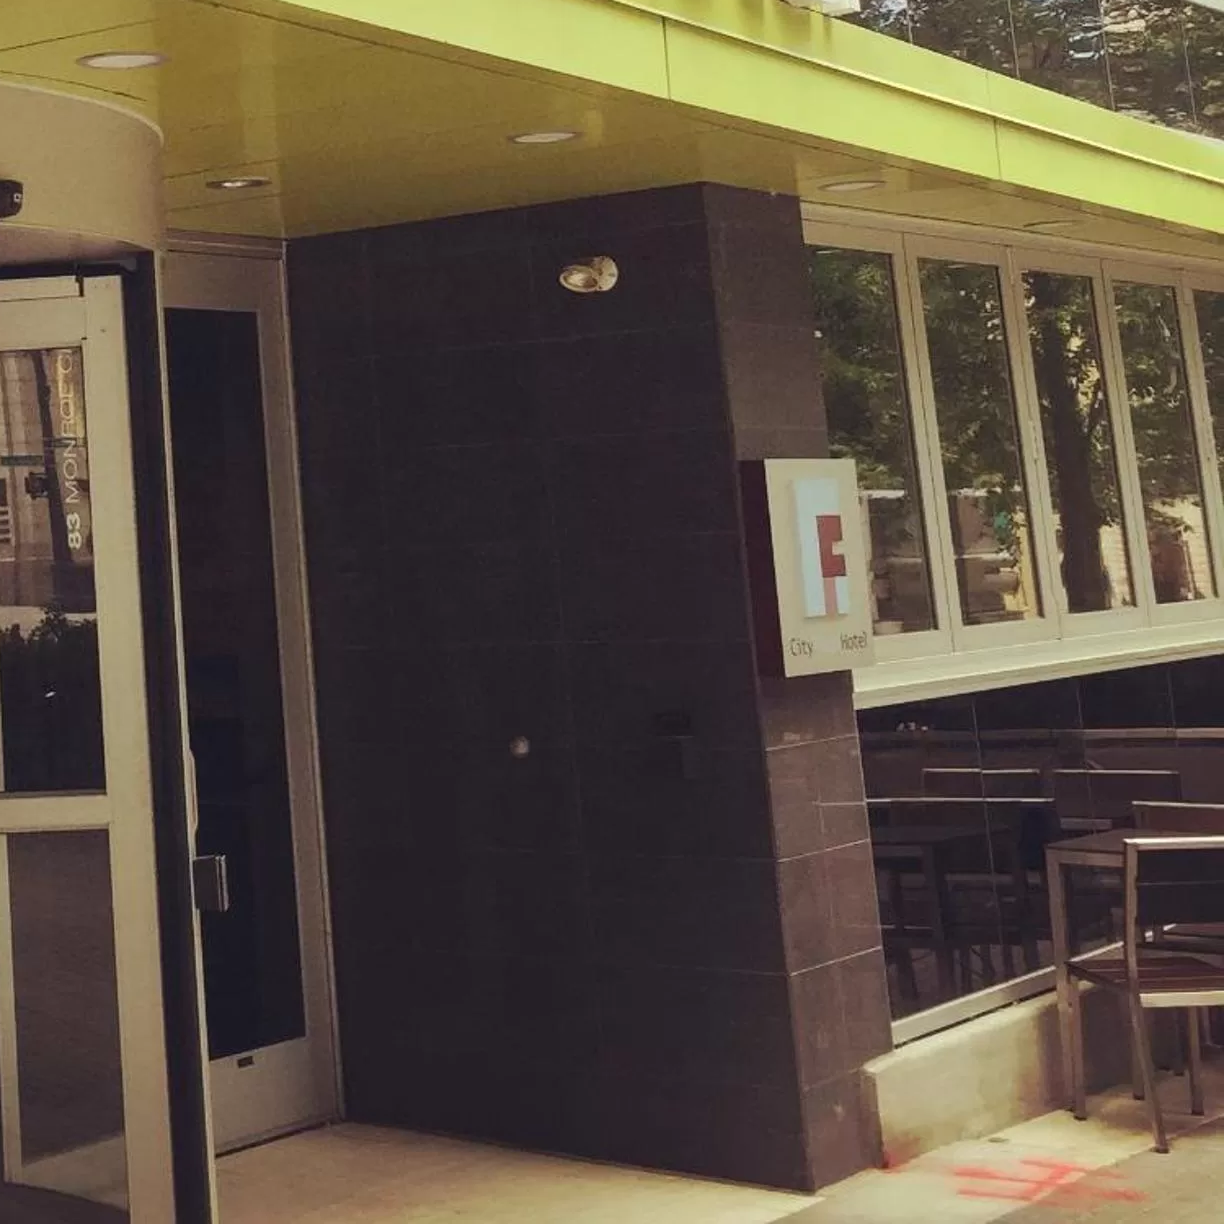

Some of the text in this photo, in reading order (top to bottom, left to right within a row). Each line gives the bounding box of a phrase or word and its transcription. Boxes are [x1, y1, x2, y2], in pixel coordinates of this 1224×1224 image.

[58, 378, 80, 503] MONROE
[66, 513, 83, 550] 83
[789, 631, 868, 658] City Hotel
